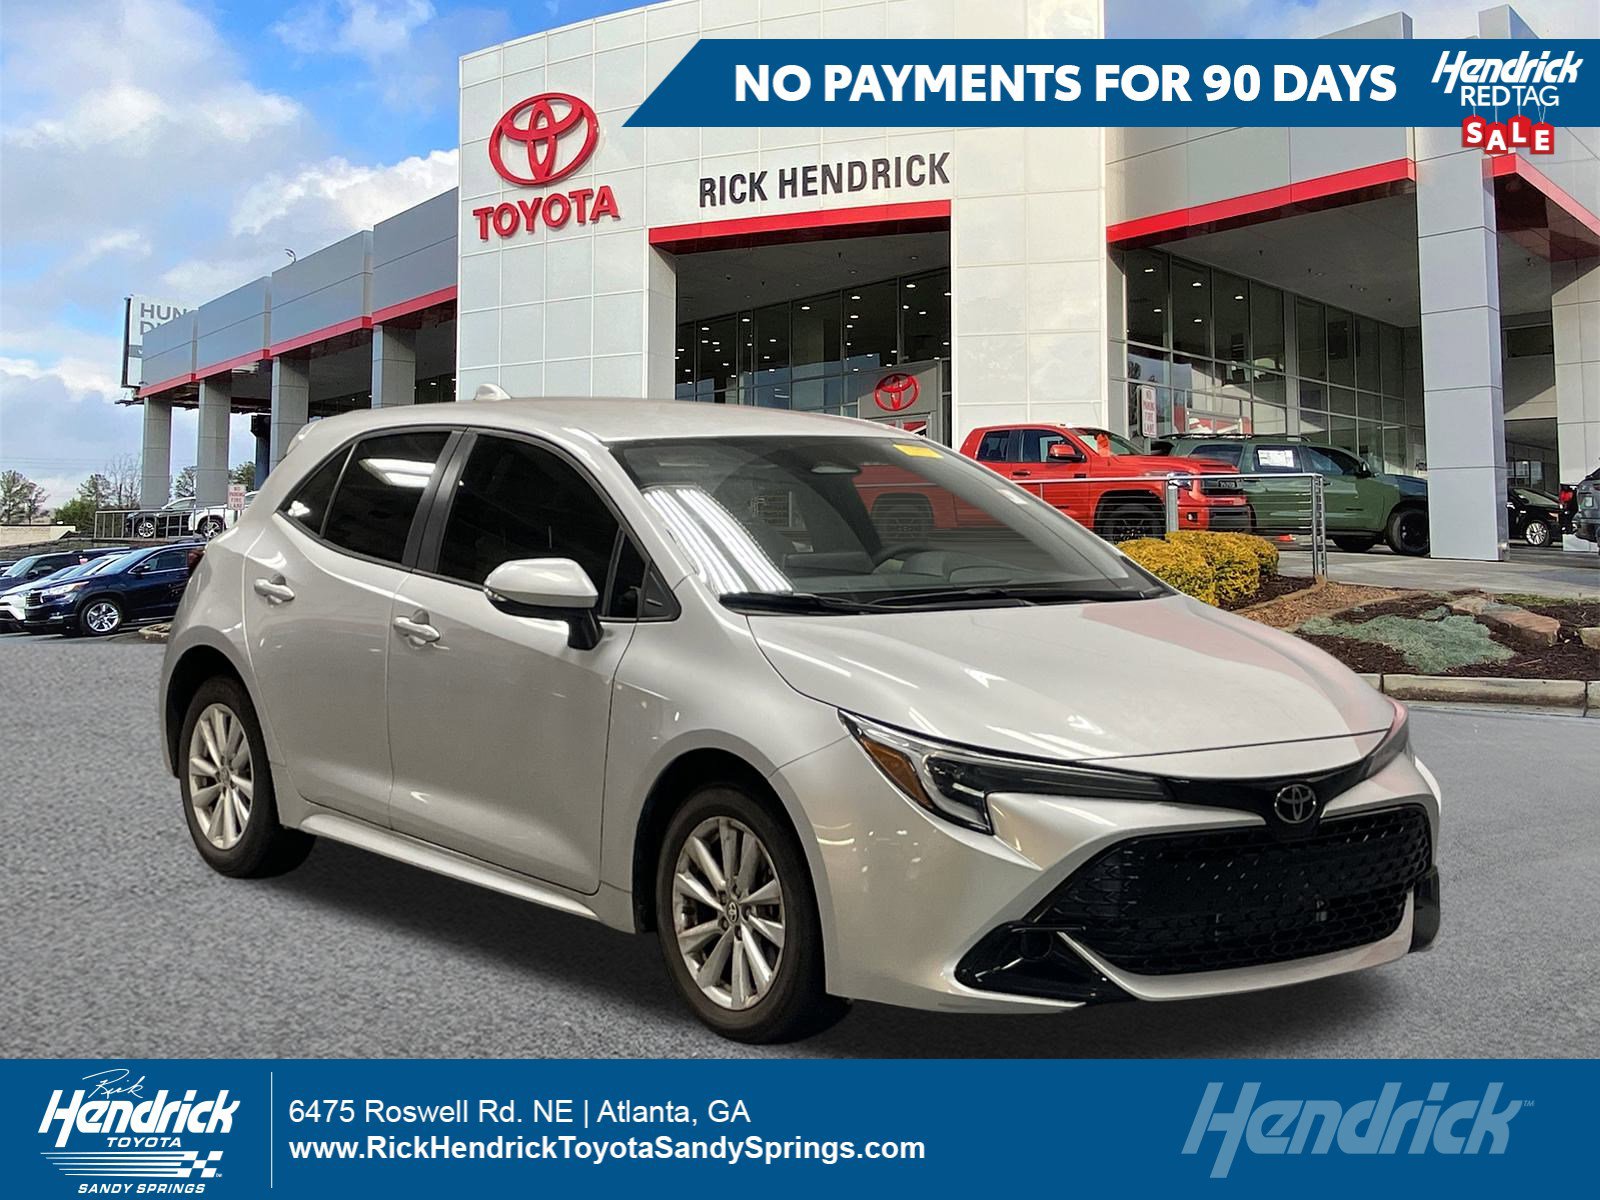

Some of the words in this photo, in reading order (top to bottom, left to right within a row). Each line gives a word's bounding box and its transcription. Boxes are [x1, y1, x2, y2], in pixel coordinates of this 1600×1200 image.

[700, 171, 768, 207] RICK
[779, 152, 949, 198] HENDRICK
[473, 186, 620, 239] TOYOTA
